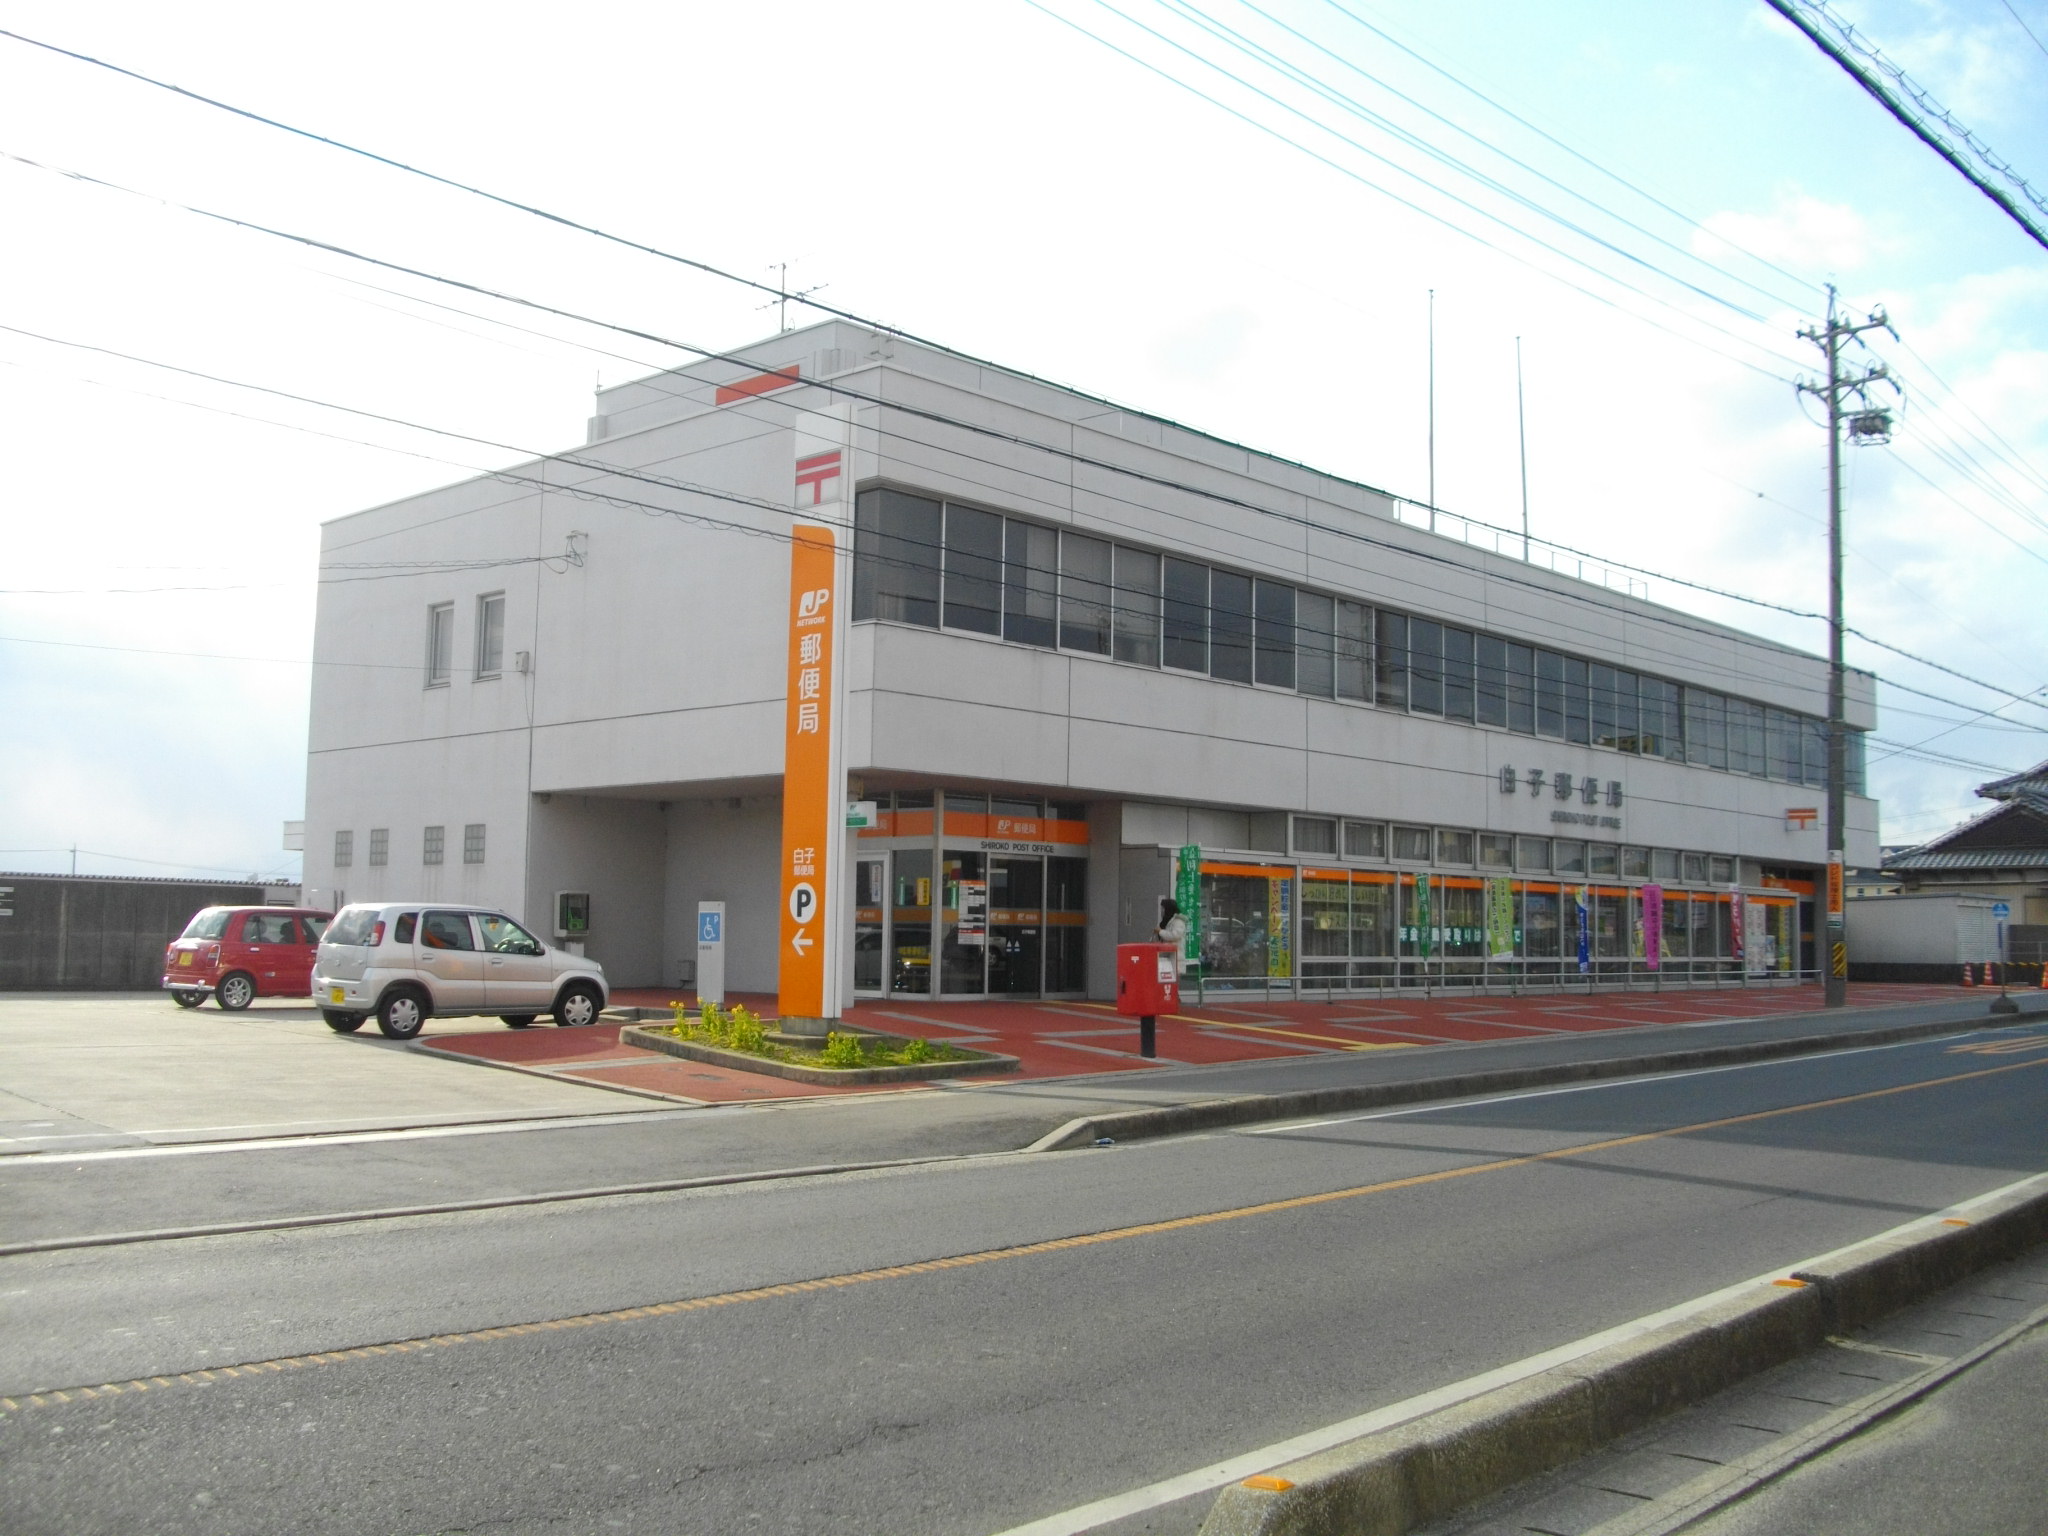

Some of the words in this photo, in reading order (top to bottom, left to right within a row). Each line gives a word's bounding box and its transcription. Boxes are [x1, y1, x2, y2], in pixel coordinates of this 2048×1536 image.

[797, 616, 826, 627] NETWORK
[797, 633, 822, 735] 郵便局
[1500, 764, 1623, 808] 白子郵便局
[1014, 822, 1036, 834] 郵便局
[980, 840, 1009, 850] SHIROKO
[1012, 843, 1029, 852] POST
[1032, 845, 1055, 853] OFFICE
[793, 847, 815, 864] 白子
[797, 888, 812, 918] P
[713, 915, 719, 925] P
